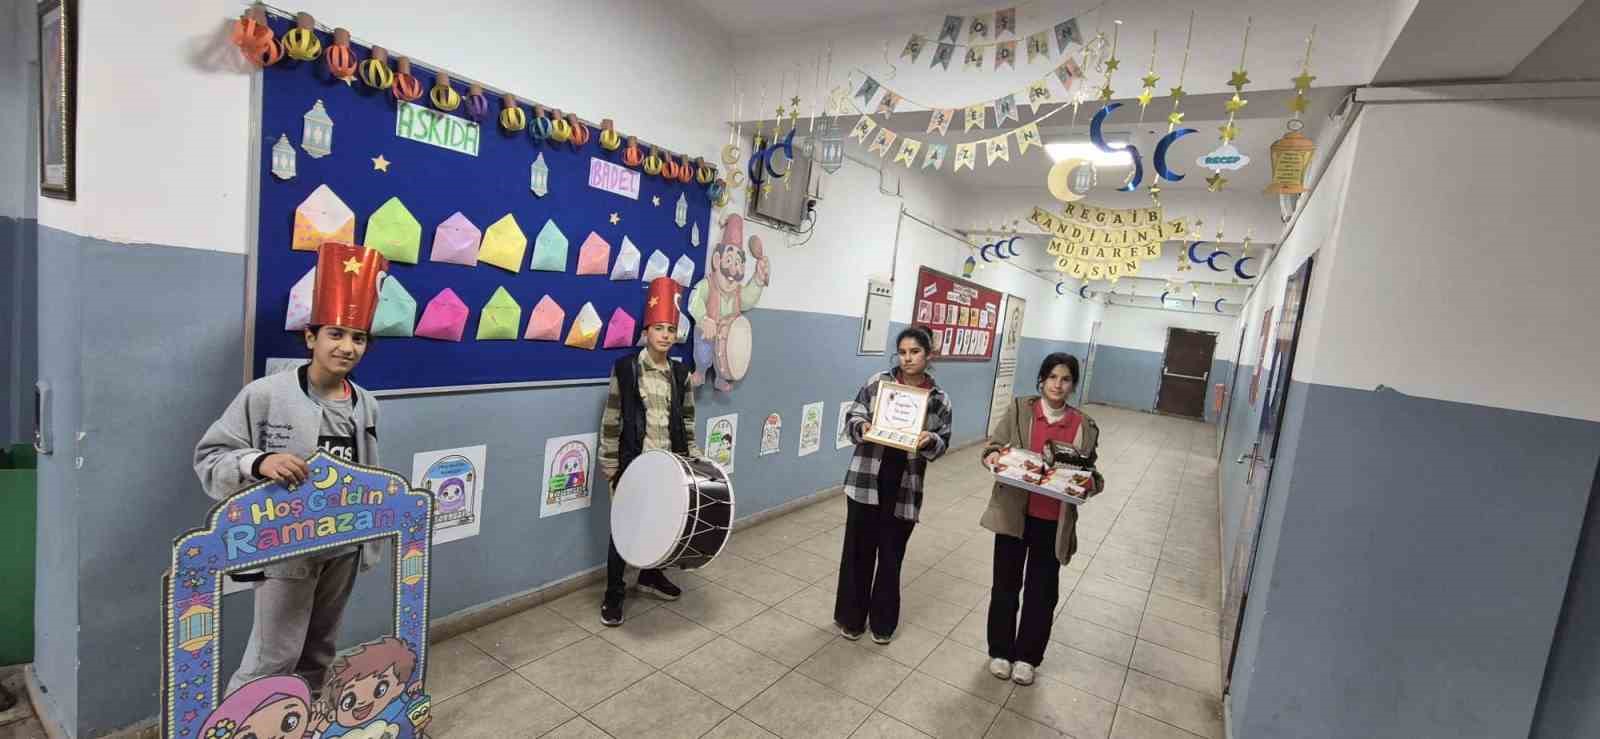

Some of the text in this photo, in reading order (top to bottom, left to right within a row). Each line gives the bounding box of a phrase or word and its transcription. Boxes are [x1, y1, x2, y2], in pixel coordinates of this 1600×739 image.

[399, 102, 478, 154] ASKIDA
[858, 121, 1034, 161] RAMAZAN
[1031, 209, 1185, 243] KANDİLİNİZ
[1065, 202, 1158, 224] REGAİB
[1049, 240, 1157, 258] MÜBAREK
[1058, 258, 1137, 276] OLSUN
[250, 484, 385, 525] Hoş Geldin
[223, 508, 396, 561] Ramazan
